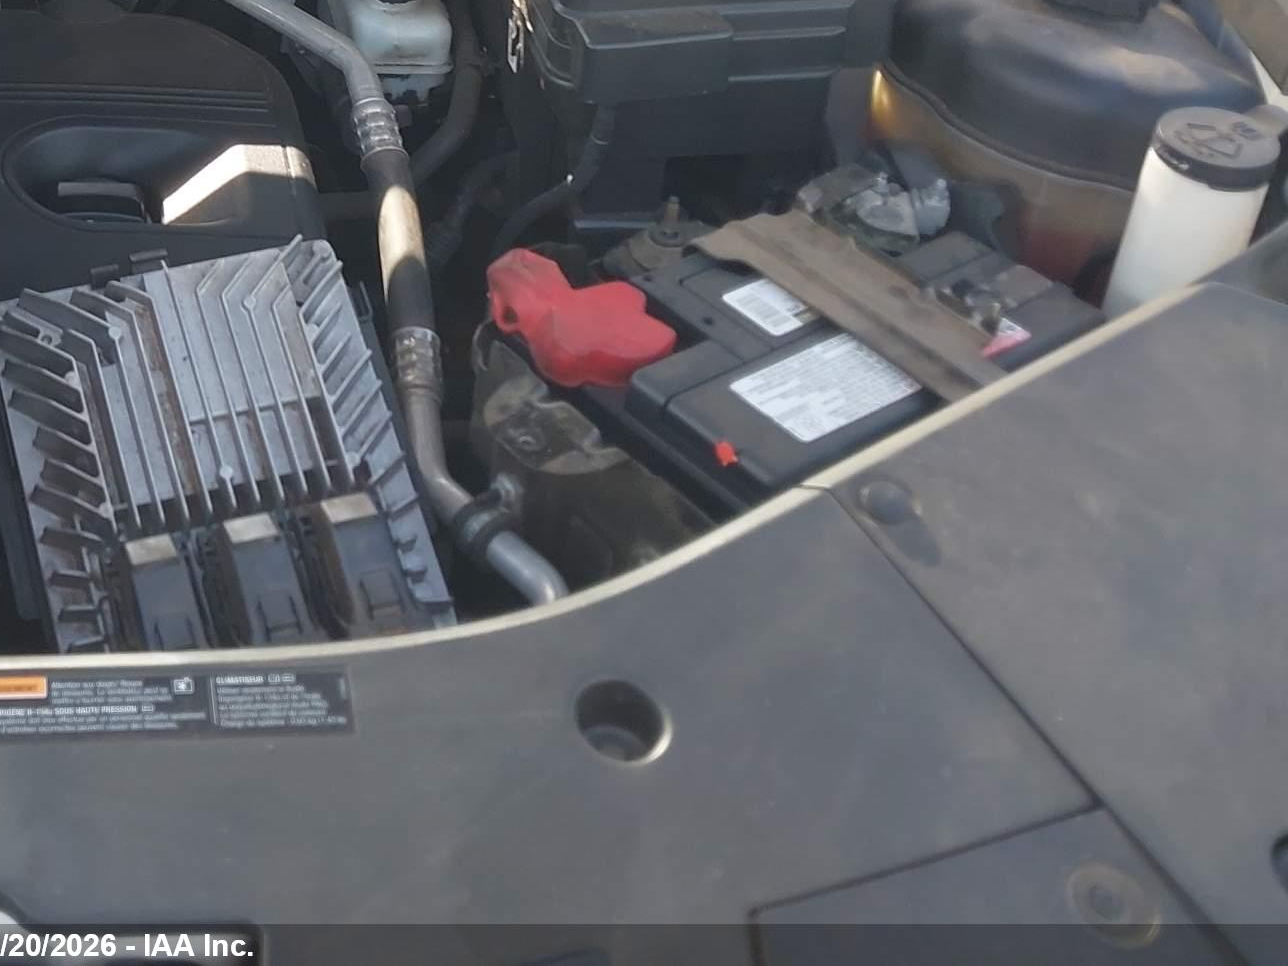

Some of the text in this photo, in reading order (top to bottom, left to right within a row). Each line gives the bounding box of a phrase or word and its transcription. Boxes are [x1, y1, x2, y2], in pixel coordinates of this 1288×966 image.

[215, 675, 264, 684] CLIMATISEUR
[54, 706, 74, 714] SOUS
[75, 706, 99, 714] HAUTE
[101, 705, 137, 713] PRESSION
